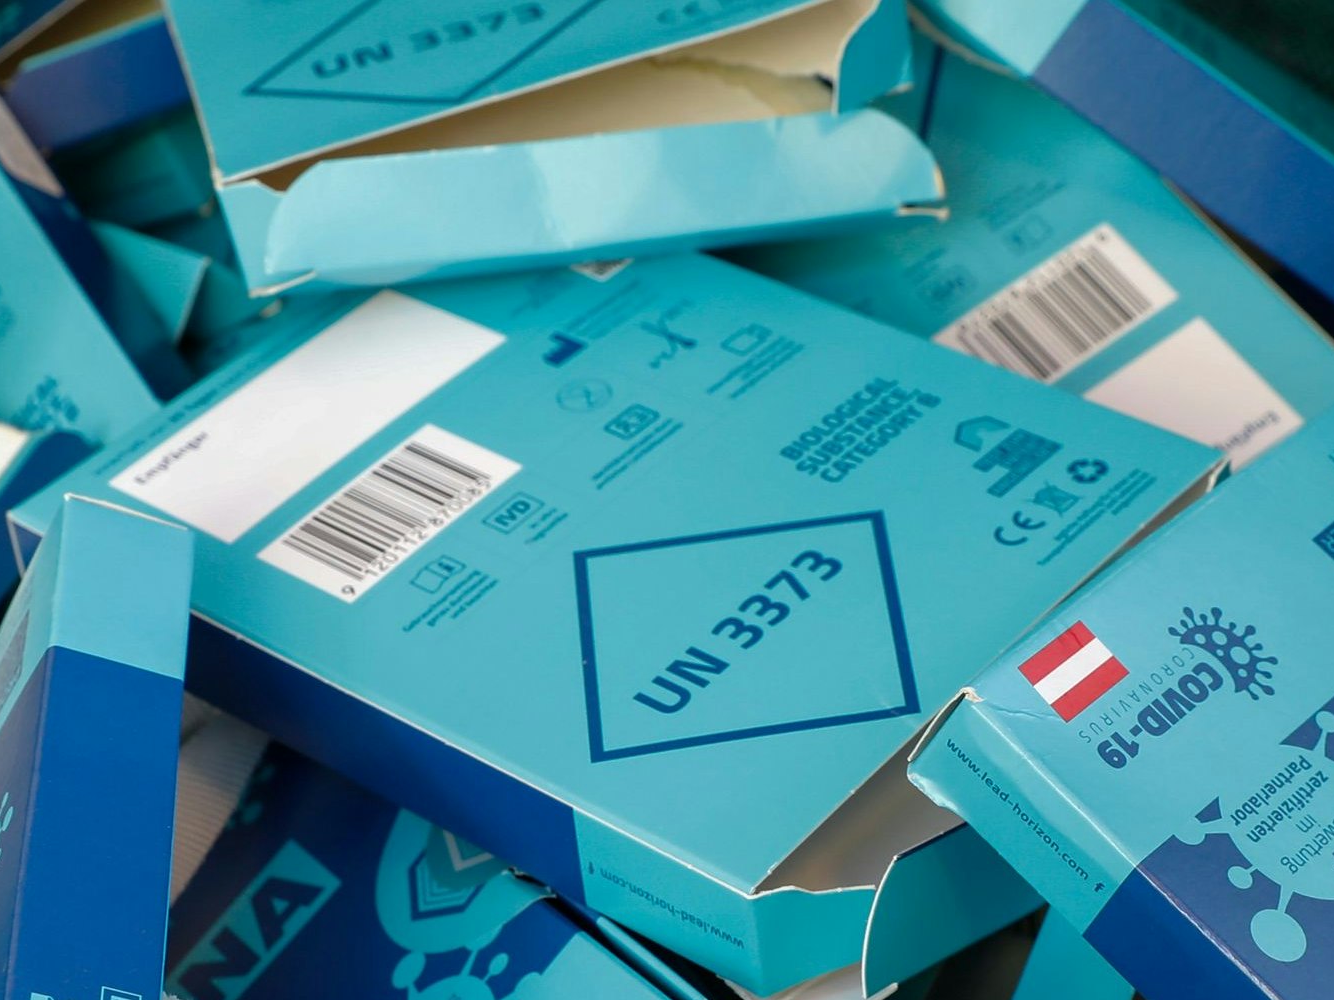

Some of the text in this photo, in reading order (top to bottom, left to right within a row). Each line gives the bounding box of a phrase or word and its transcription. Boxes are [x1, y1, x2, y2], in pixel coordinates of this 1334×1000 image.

[311, 2, 545, 79] UN 3373
[779, 377, 899, 462] BIOLOGICAL
[820, 404, 924, 483] CATEGORY
[493, 499, 532, 527] IVD
[341, 583, 356, 595] 9
[632, 549, 844, 714] UN 3373
[1078, 646, 1196, 744] CORONAVIRUS
[1096, 661, 1224, 769] COVID-19
[946, 738, 1090, 881] www.lead-horizon.com
[1229, 754, 1313, 826] Partnerlabor
[1246, 770, 1330, 843] zertifizierten
[1295, 814, 1322, 834] im
[600, 867, 745, 949] www.lead-horizon.com
